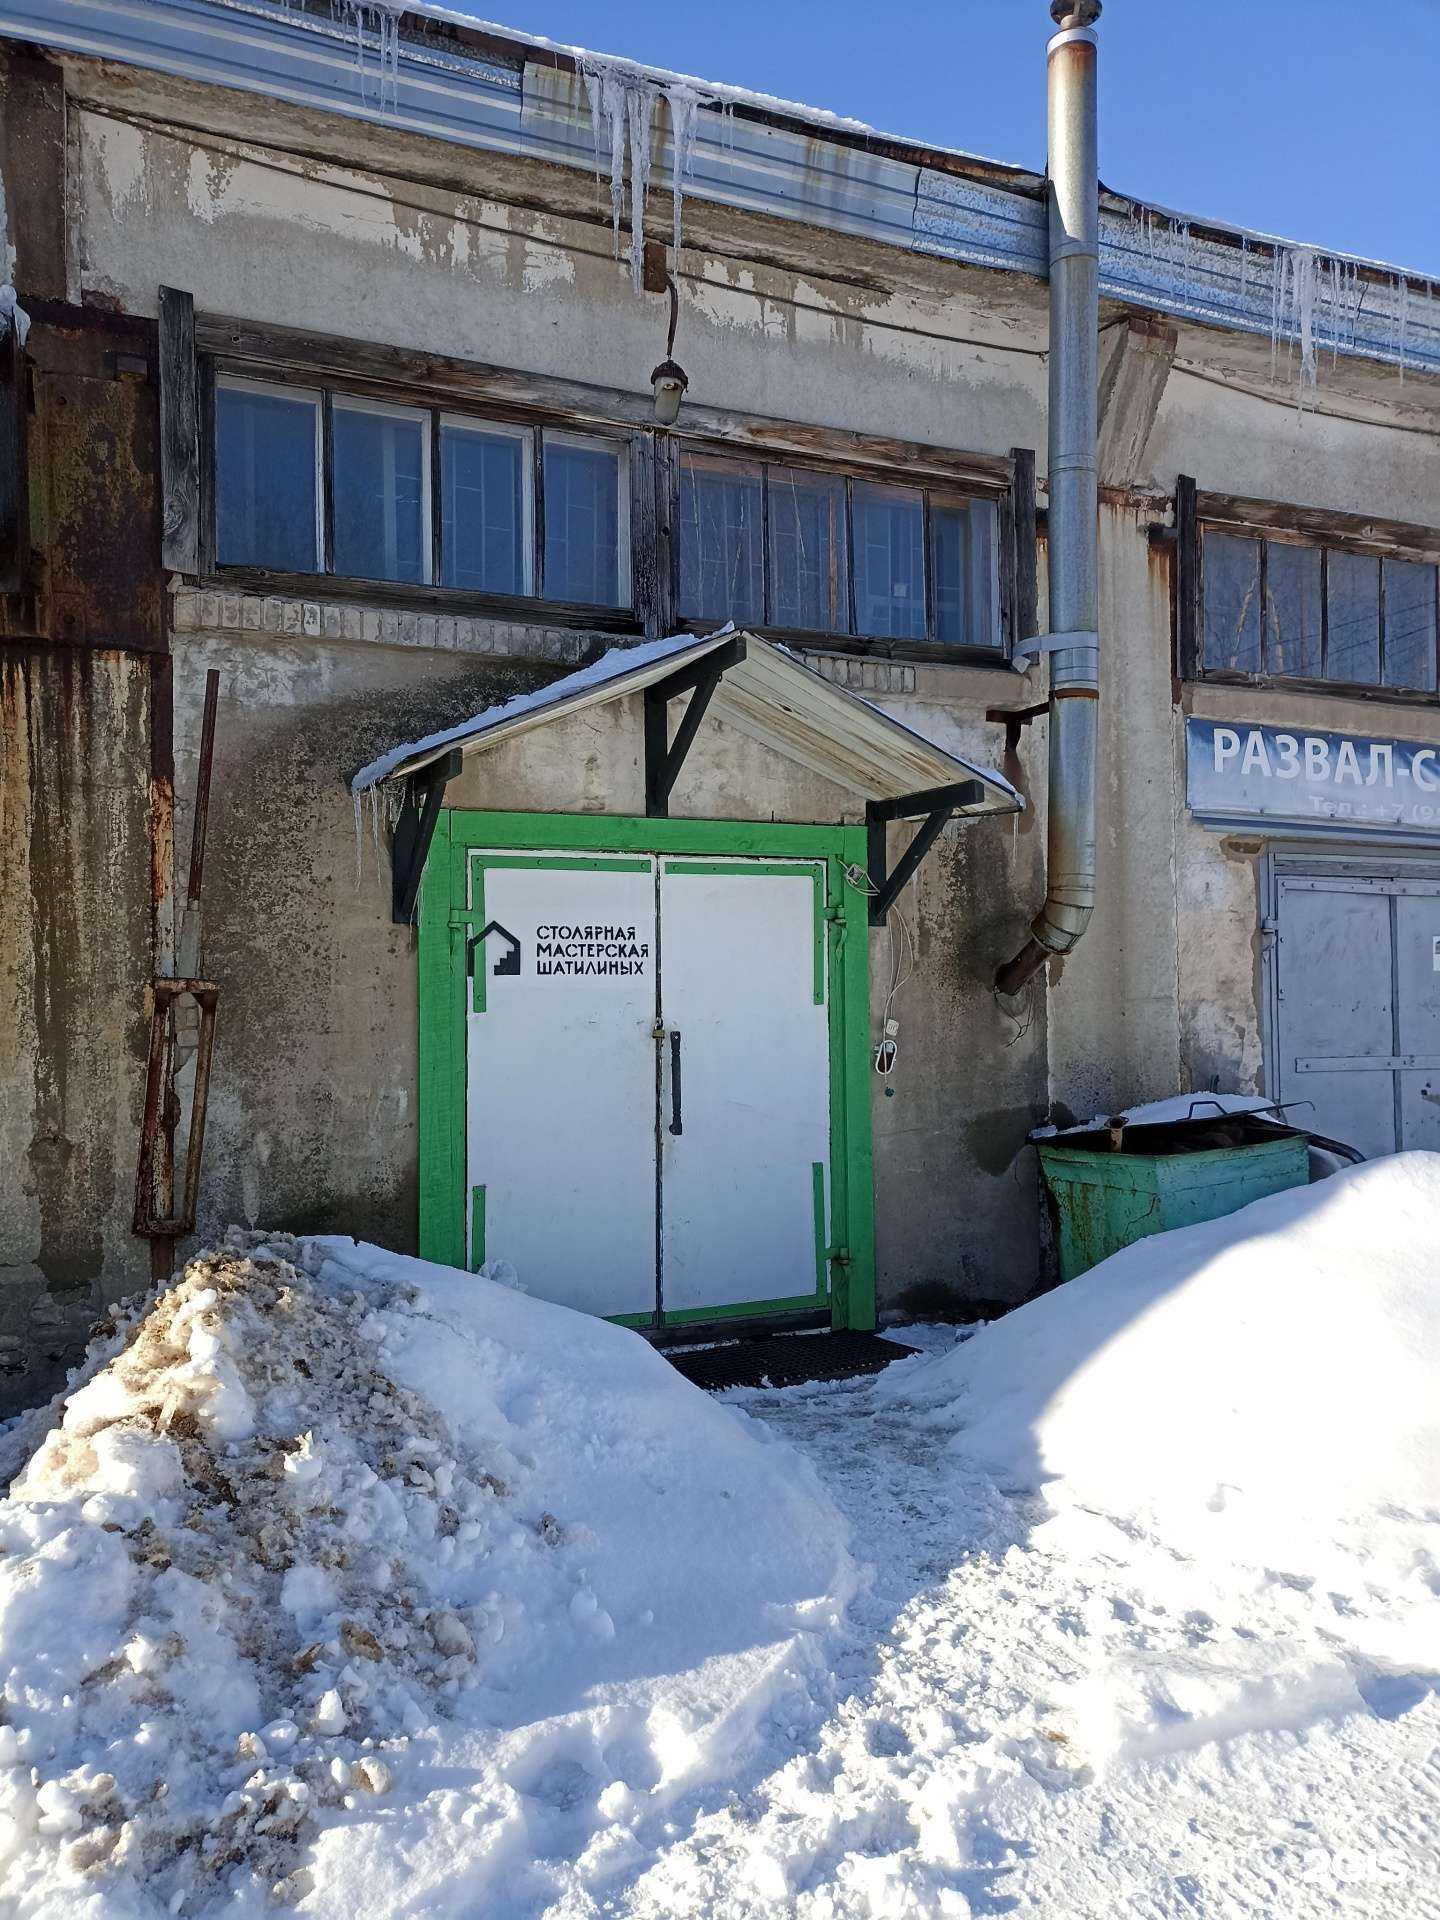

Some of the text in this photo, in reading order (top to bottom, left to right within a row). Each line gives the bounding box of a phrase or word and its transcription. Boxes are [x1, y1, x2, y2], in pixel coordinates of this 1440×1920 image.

[1213, 727, 1440, 793] РАЗВАЛ-С
[1412, 803, 1440, 823] (9
[536, 925, 636, 940] СТОЛЯРНАЯ
[536, 943, 649, 958] МАСТЕРСКАЯ
[536, 960, 644, 976] ШАТИЛИНЫХ
